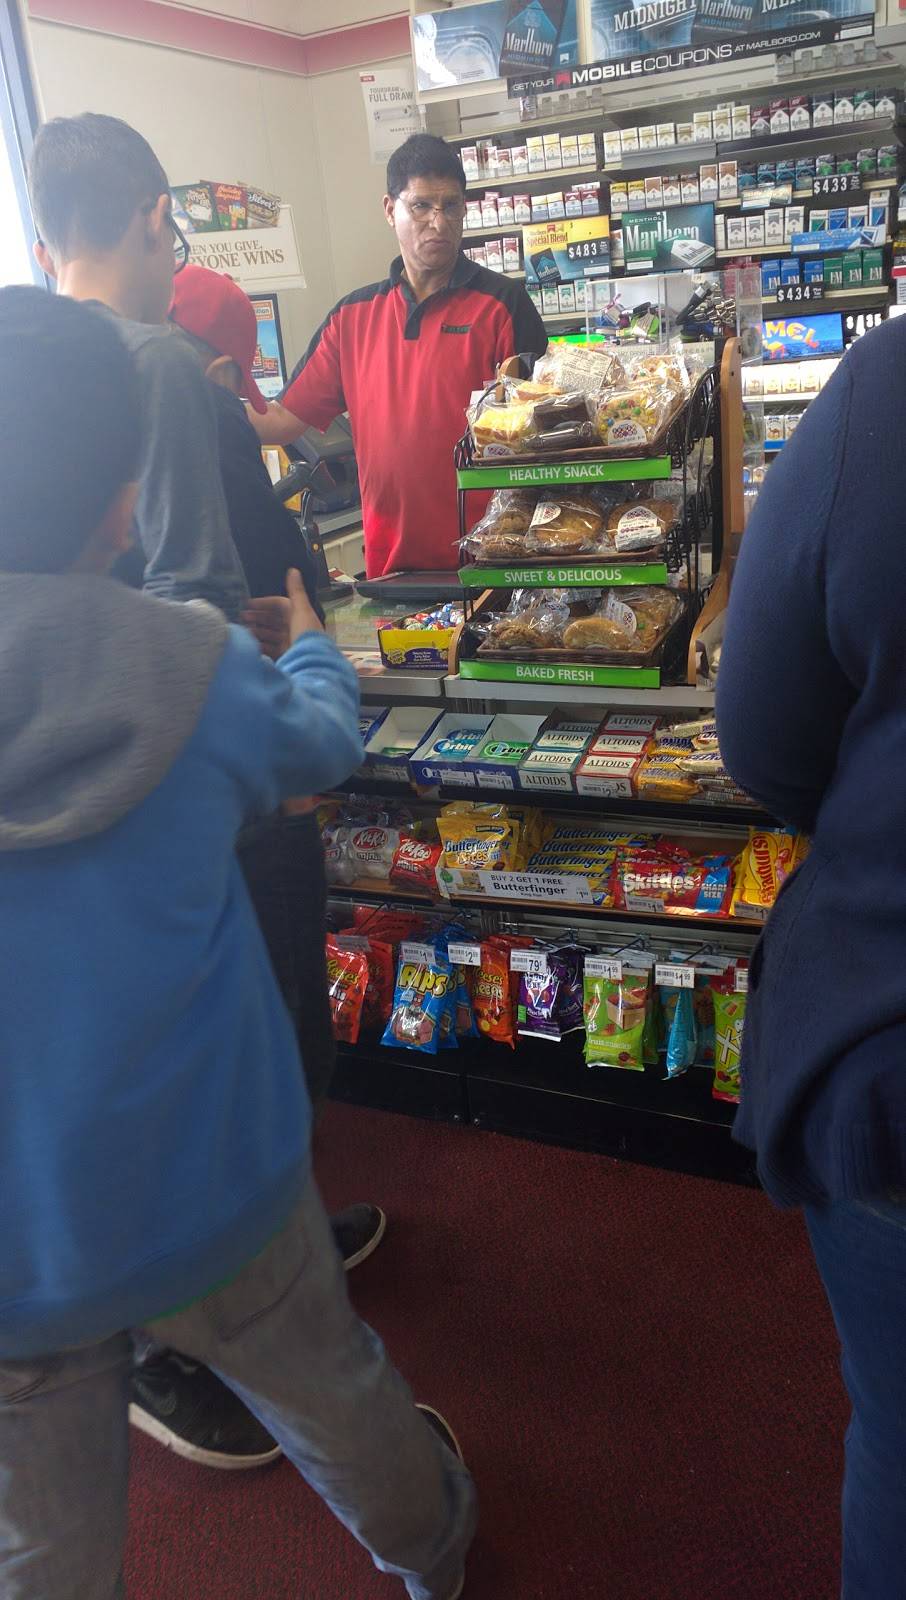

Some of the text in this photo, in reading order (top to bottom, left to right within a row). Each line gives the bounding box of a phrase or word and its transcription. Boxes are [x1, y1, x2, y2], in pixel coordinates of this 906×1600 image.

[505, 28, 553, 57] Marlboro
[513, 82, 529, 92] GET
[530, 78, 554, 89] YOUR
[734, 44, 745, 53] AT
[746, 31, 821, 51] MARLBORO.COM
[369, 91, 413, 102] FULL DRAW
[550, 231, 568, 243] Blend
[626, 211, 699, 252] Marlboro
[209, 241, 232, 253] YOU
[234, 240, 263, 251] GIVE,
[243, 249, 284, 265] WINS
[762, 320, 819, 349] MEL
[509, 465, 604, 481] HEALTHY SNACK
[504, 569, 622, 583] SWEET & DELICIOUS
[516, 666, 594, 681] BAKED FRESH
[545, 733, 585, 743] ALTOIDS
[599, 738, 641, 747] ALTOIDS
[433, 739, 475, 753] Orbit
[491, 742, 528, 755] Orbit
[531, 753, 572, 763] ALTOIDS
[588, 758, 631, 768] ALTOIDS
[525, 775, 567, 786] ALTOIDS
[528, 853, 609, 868] Butterfinger
[493, 882, 567, 896] Butterfinger
[623, 872, 695, 892] Skittles
[704, 891, 721, 899] SIZE
